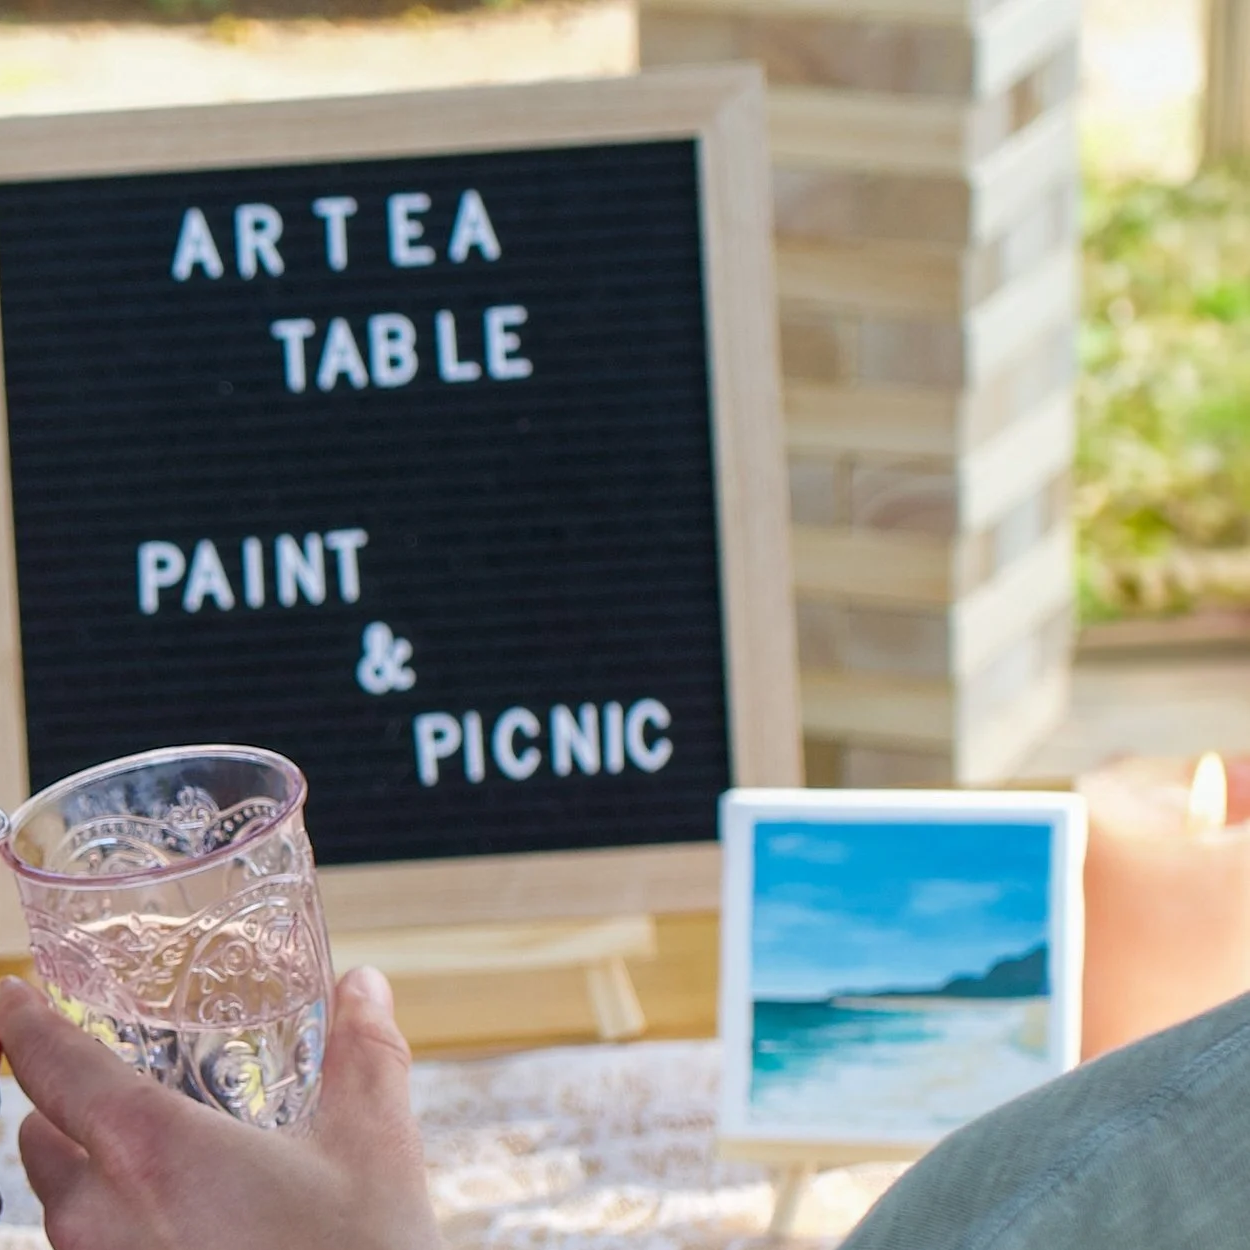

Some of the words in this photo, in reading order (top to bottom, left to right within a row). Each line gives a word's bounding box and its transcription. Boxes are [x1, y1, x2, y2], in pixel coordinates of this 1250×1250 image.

[272, 305, 533, 392] TABLE
[138, 528, 368, 614] PAINT
[357, 621, 416, 695] &
[414, 698, 674, 786] PICNIC
